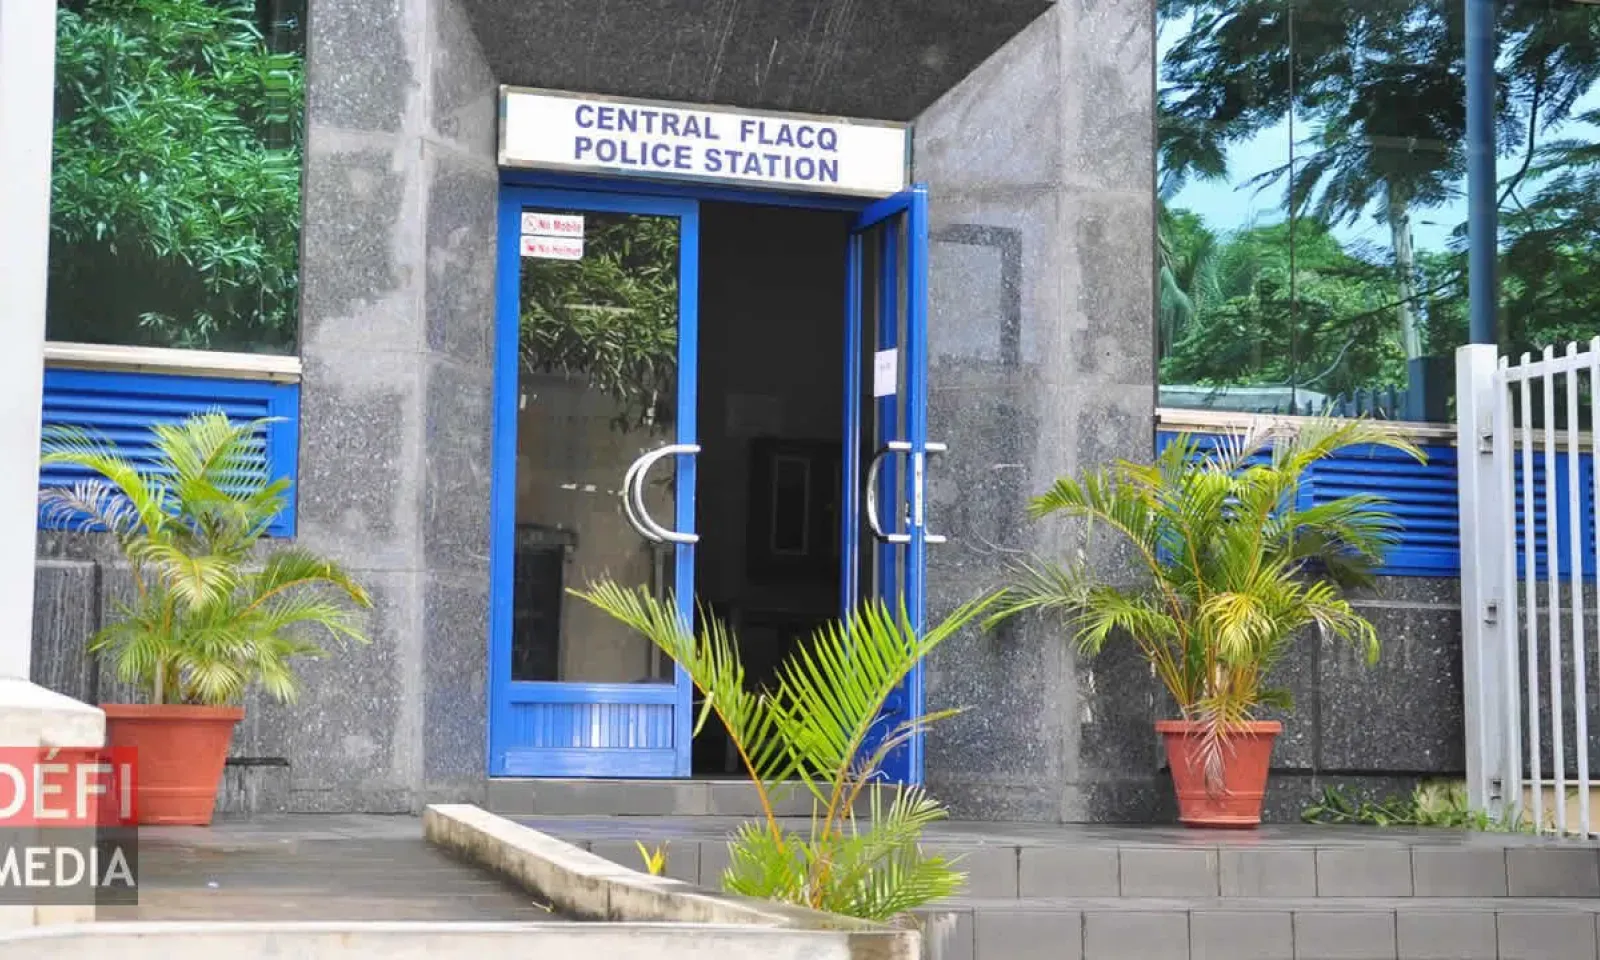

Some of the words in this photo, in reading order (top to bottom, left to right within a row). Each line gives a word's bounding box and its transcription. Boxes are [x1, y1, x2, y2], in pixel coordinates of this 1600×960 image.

[574, 104, 720, 140] CENTRAL
[740, 119, 839, 152] FLACQ
[574, 136, 693, 169] POLICE
[703, 148, 840, 183] STATION
